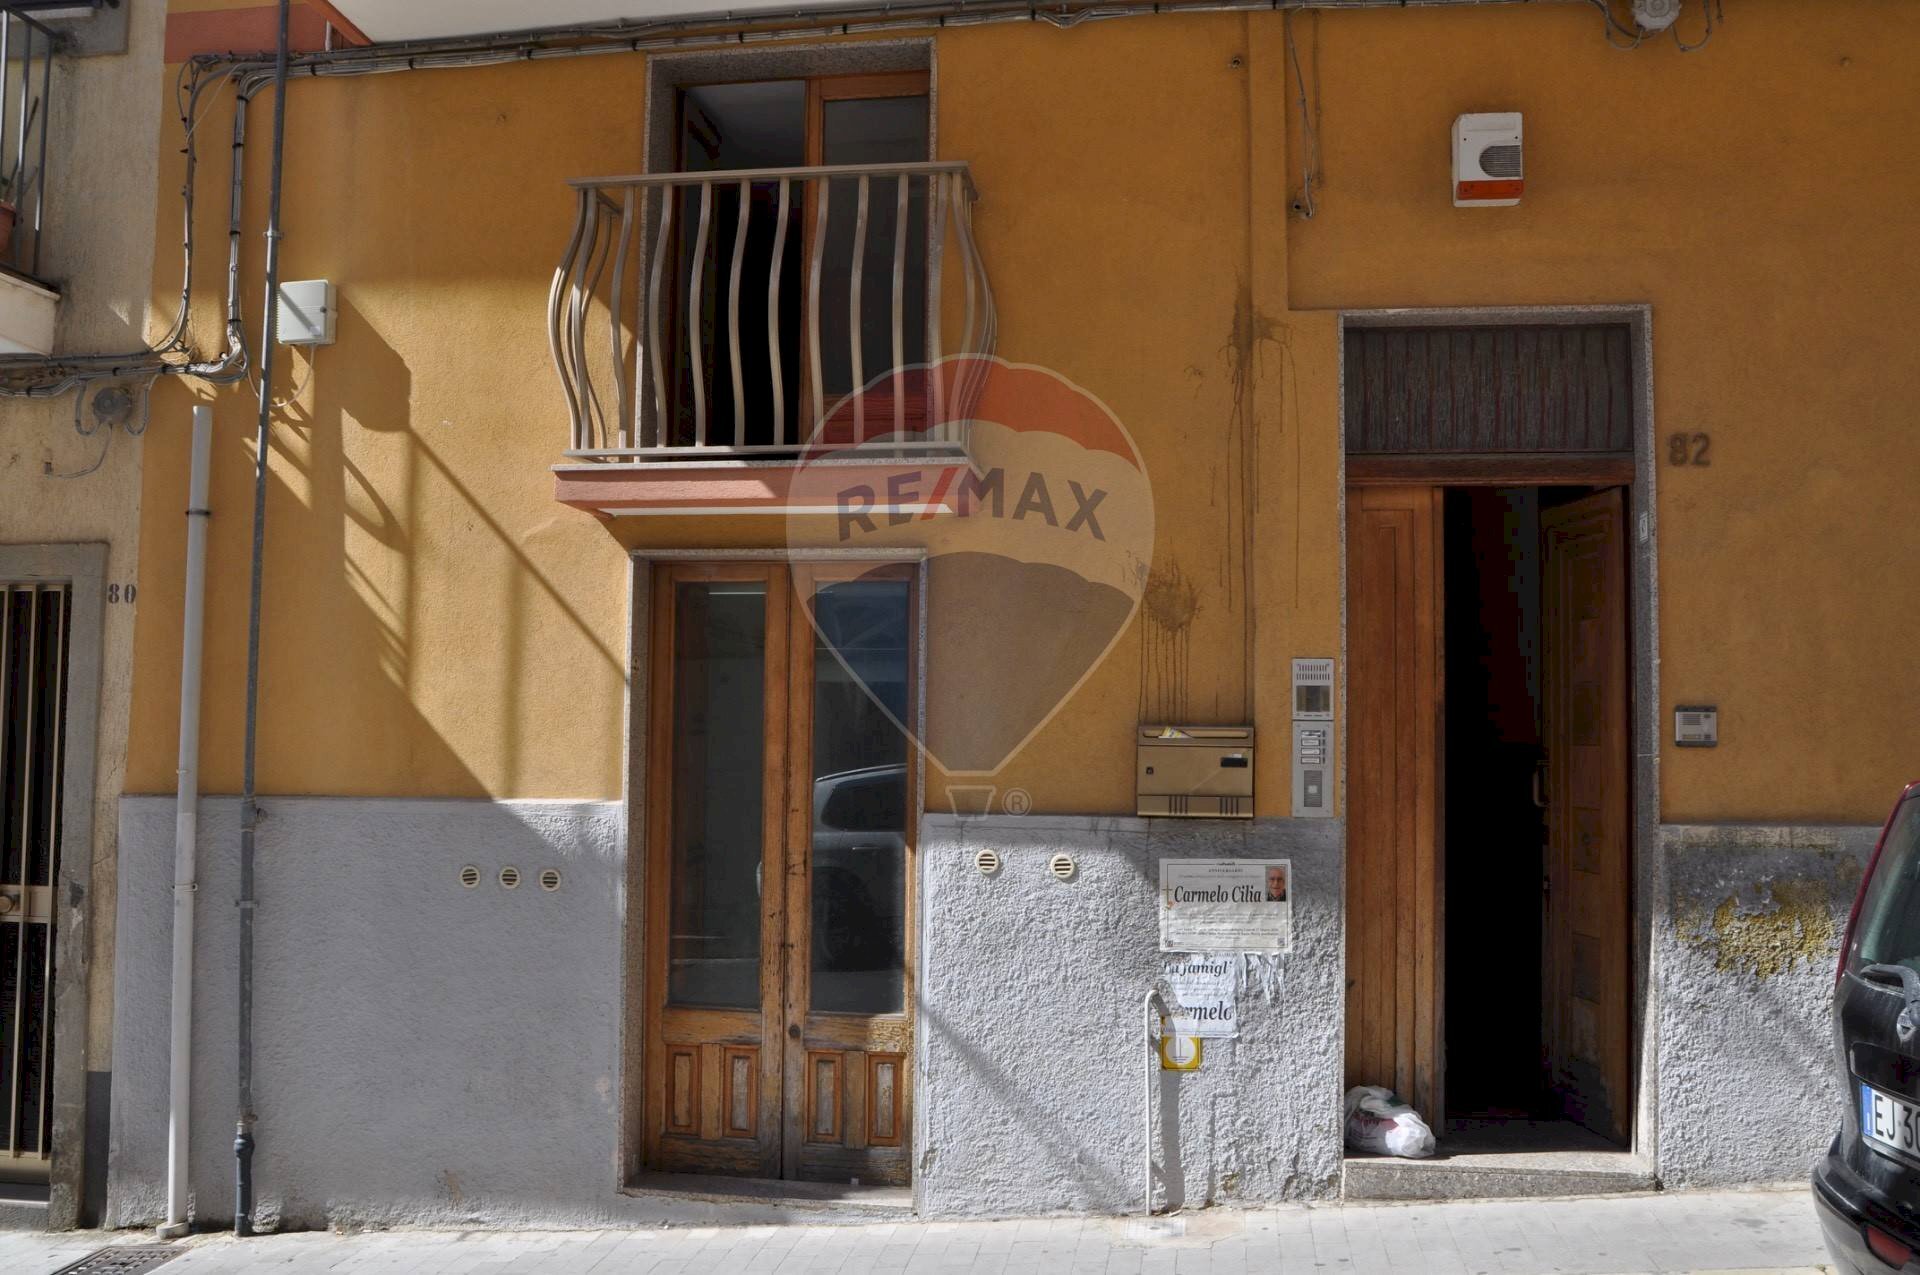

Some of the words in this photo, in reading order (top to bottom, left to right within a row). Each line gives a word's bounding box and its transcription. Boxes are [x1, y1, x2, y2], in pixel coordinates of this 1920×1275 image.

[1669, 432, 1711, 466] 82
[108, 584, 136, 604] 80
[1174, 885, 1228, 903] Carmelo
[1232, 885, 1262, 903] Cilia
[1874, 1094, 1895, 1141] EJ
